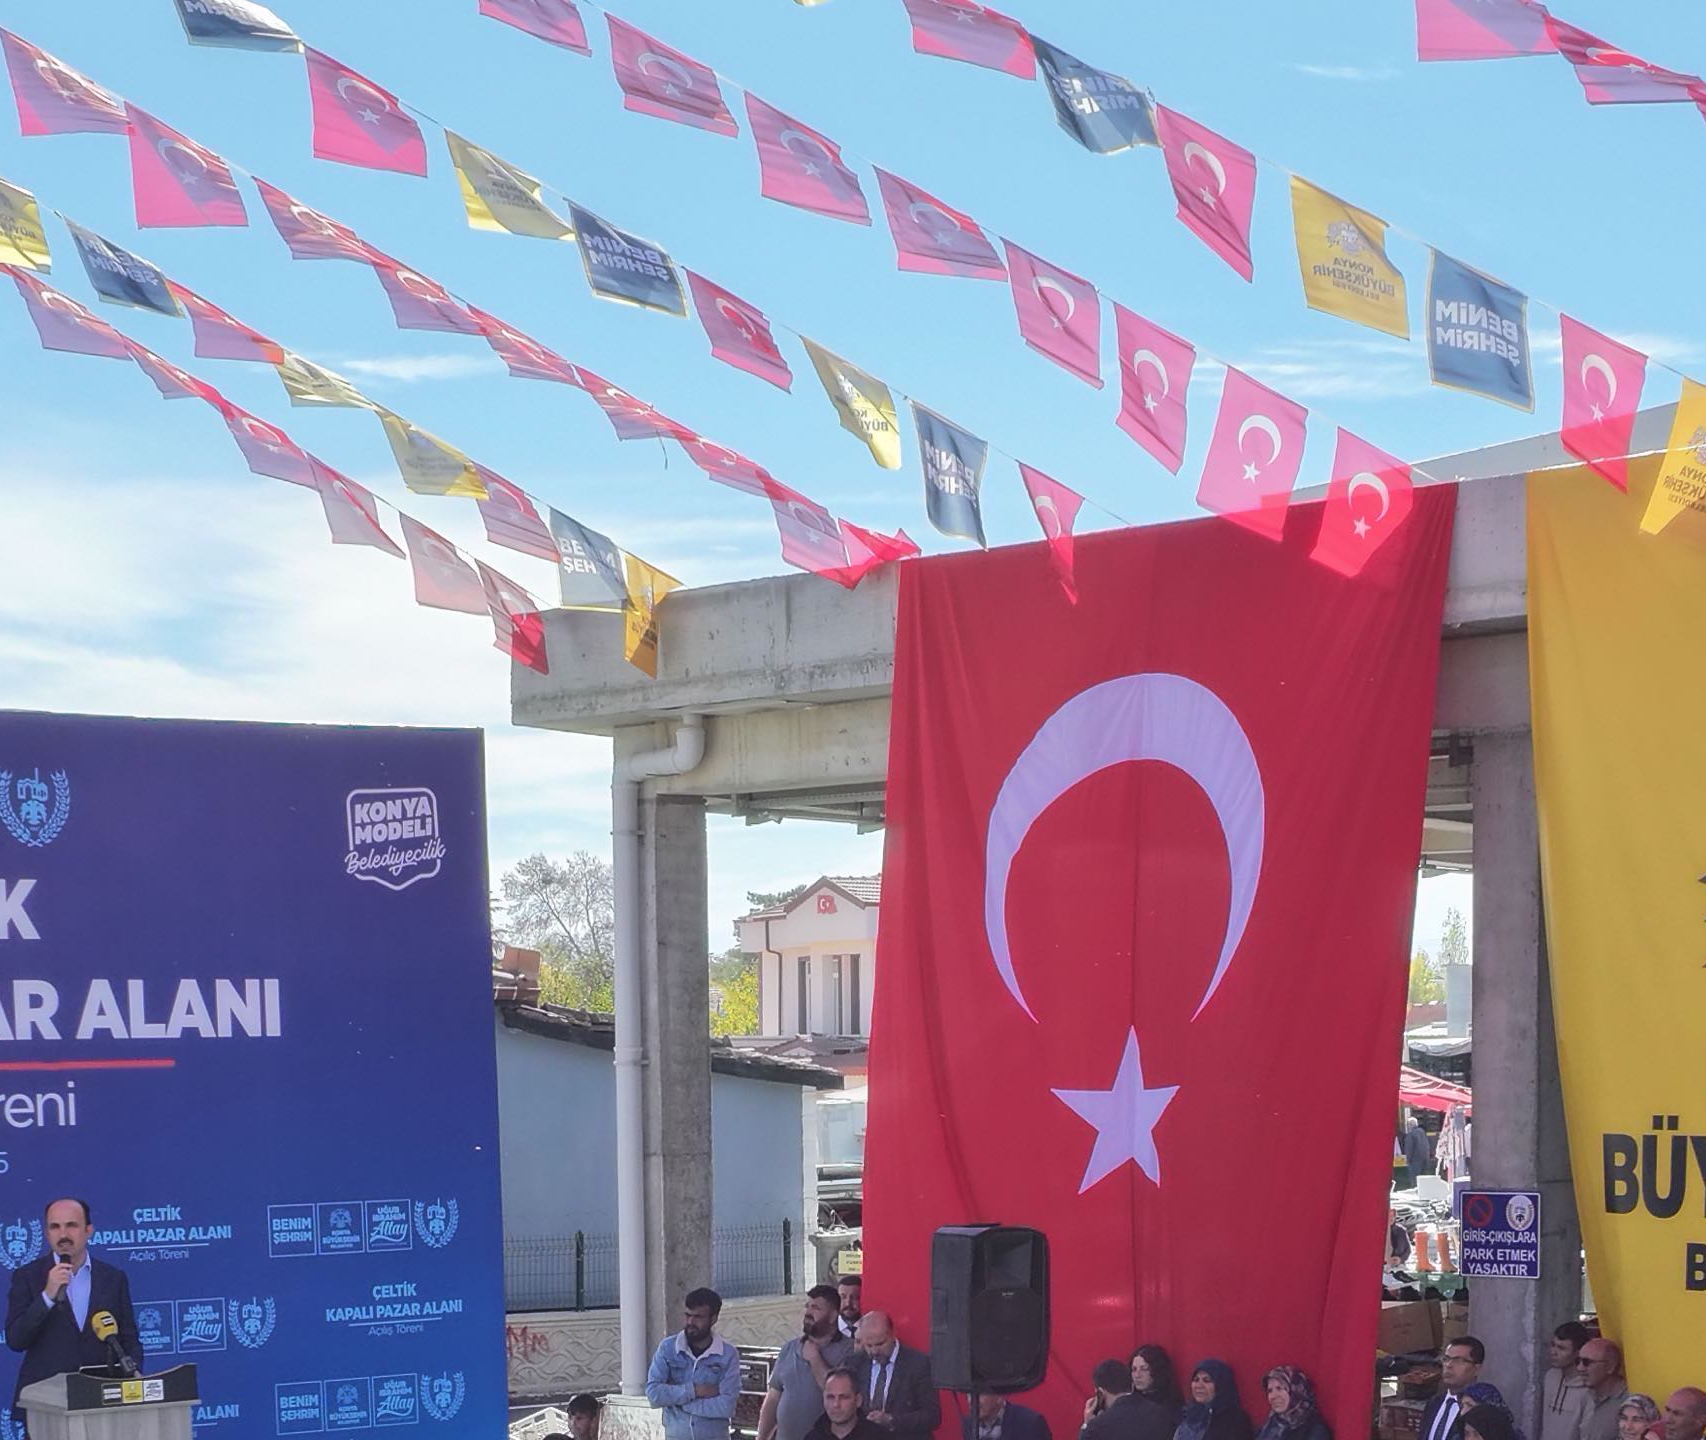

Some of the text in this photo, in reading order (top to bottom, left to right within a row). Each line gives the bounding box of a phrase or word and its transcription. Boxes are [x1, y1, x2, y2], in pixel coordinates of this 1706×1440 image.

[355, 797, 432, 824] KONYA
[355, 817, 432, 844] MODELİ
[345, 838, 446, 876] Belediyecilik
[76, 978, 282, 1040] ALANI
[133, 1204, 181, 1224] ÇELTİK
[88, 1225, 231, 1245] APALI PAZAR ALANI
[1463, 1228, 1536, 1245] GİRİŞ-ÇIKIŞLARA
[1464, 1248, 1536, 1261] PARK ETMEK
[1468, 1262, 1528, 1275] YASAKTIR
[373, 1281, 417, 1301] ÇELTİK
[326, 1299, 462, 1321] KAPALI PAZAR ALANI
[197, 1405, 239, 1420] ALANI
